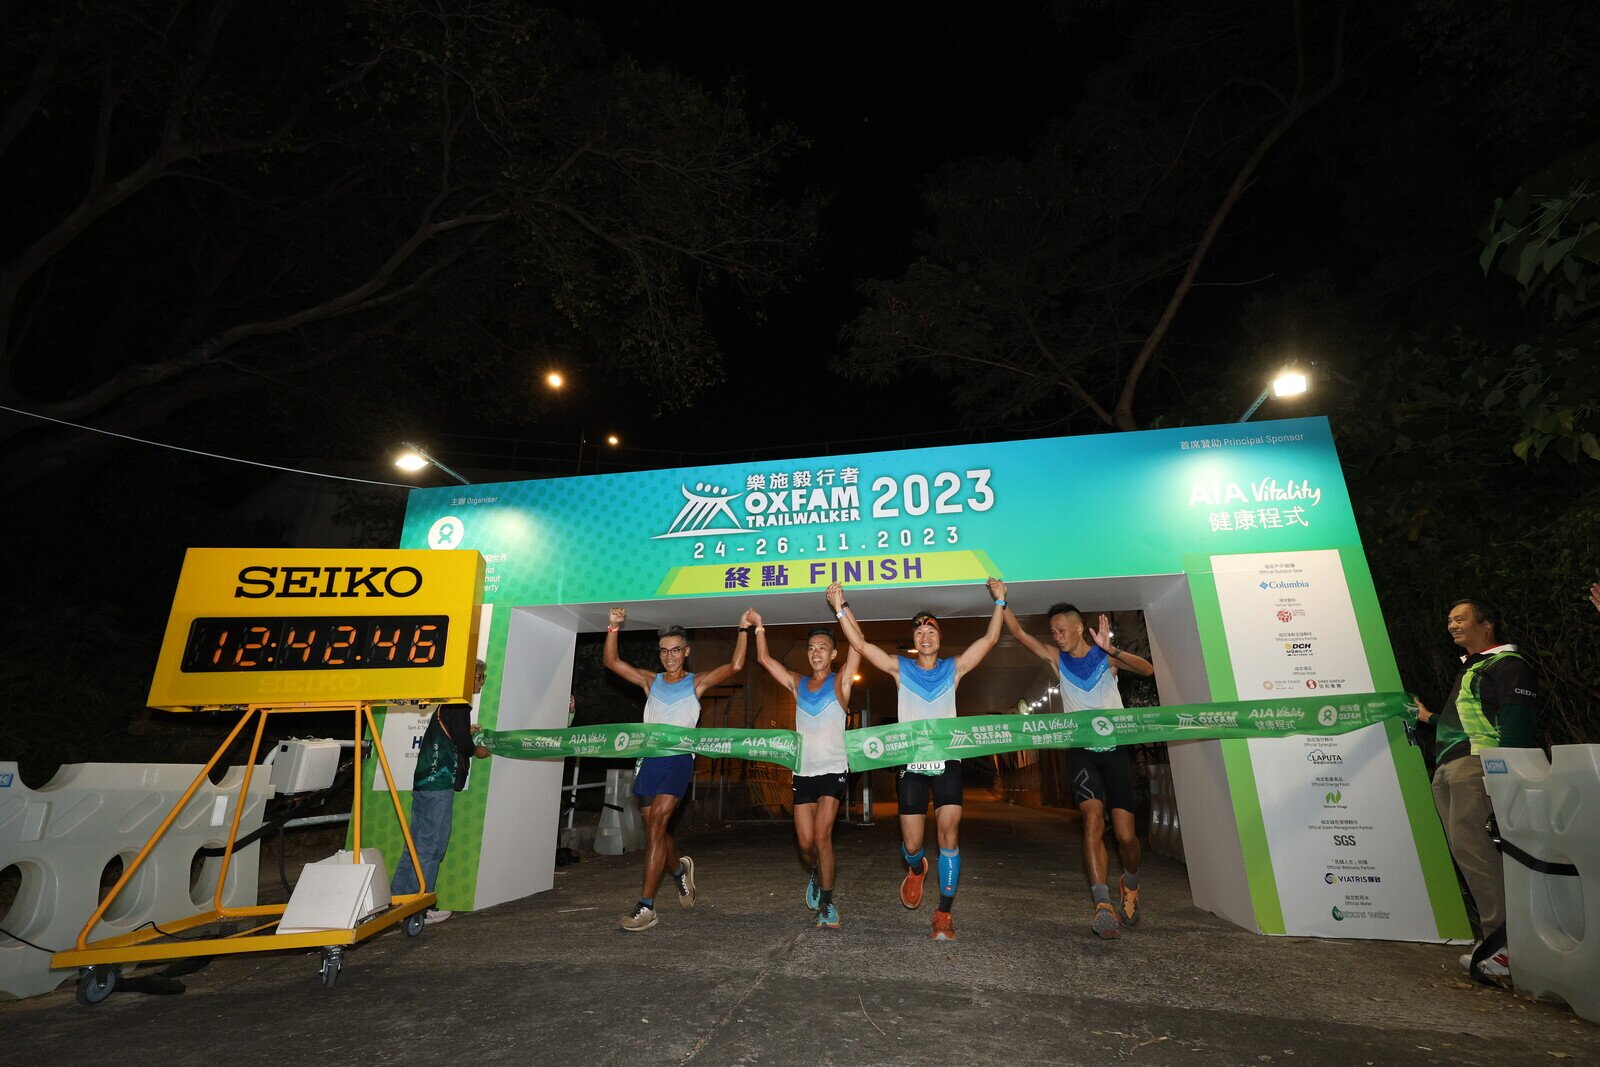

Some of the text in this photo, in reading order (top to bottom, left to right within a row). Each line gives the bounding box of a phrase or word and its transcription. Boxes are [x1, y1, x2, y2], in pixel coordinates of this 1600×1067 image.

[1224, 433, 1304, 447] Principal Sponsor
[747, 467, 860, 491] 樂施毅行者
[744, 485, 860, 514] OXFAM
[871, 469, 995, 519] 2023
[1188, 476, 1321, 507] AIA Vitality
[466, 496, 498, 506] Organiser
[745, 508, 861, 528] TRAILWALKER
[1208, 506, 1309, 532] 健康程式
[724, 565, 789, 588] 終點
[809, 557, 923, 584] FINISH
[234, 566, 422, 599] SEIKO
[1269, 580, 1310, 589] Columbia
[1248, 707, 1274, 719] AIA
[1338, 712, 1362, 720] OXFAM
[1022, 717, 1079, 733] AIA Vitality
[569, 733, 587, 745] AIA
[973, 730, 1012, 740] OXFAM
[741, 736, 797, 755] AIA Vitality
[885, 741, 908, 751] OXFAM
[1333, 835, 1356, 846] SGS
